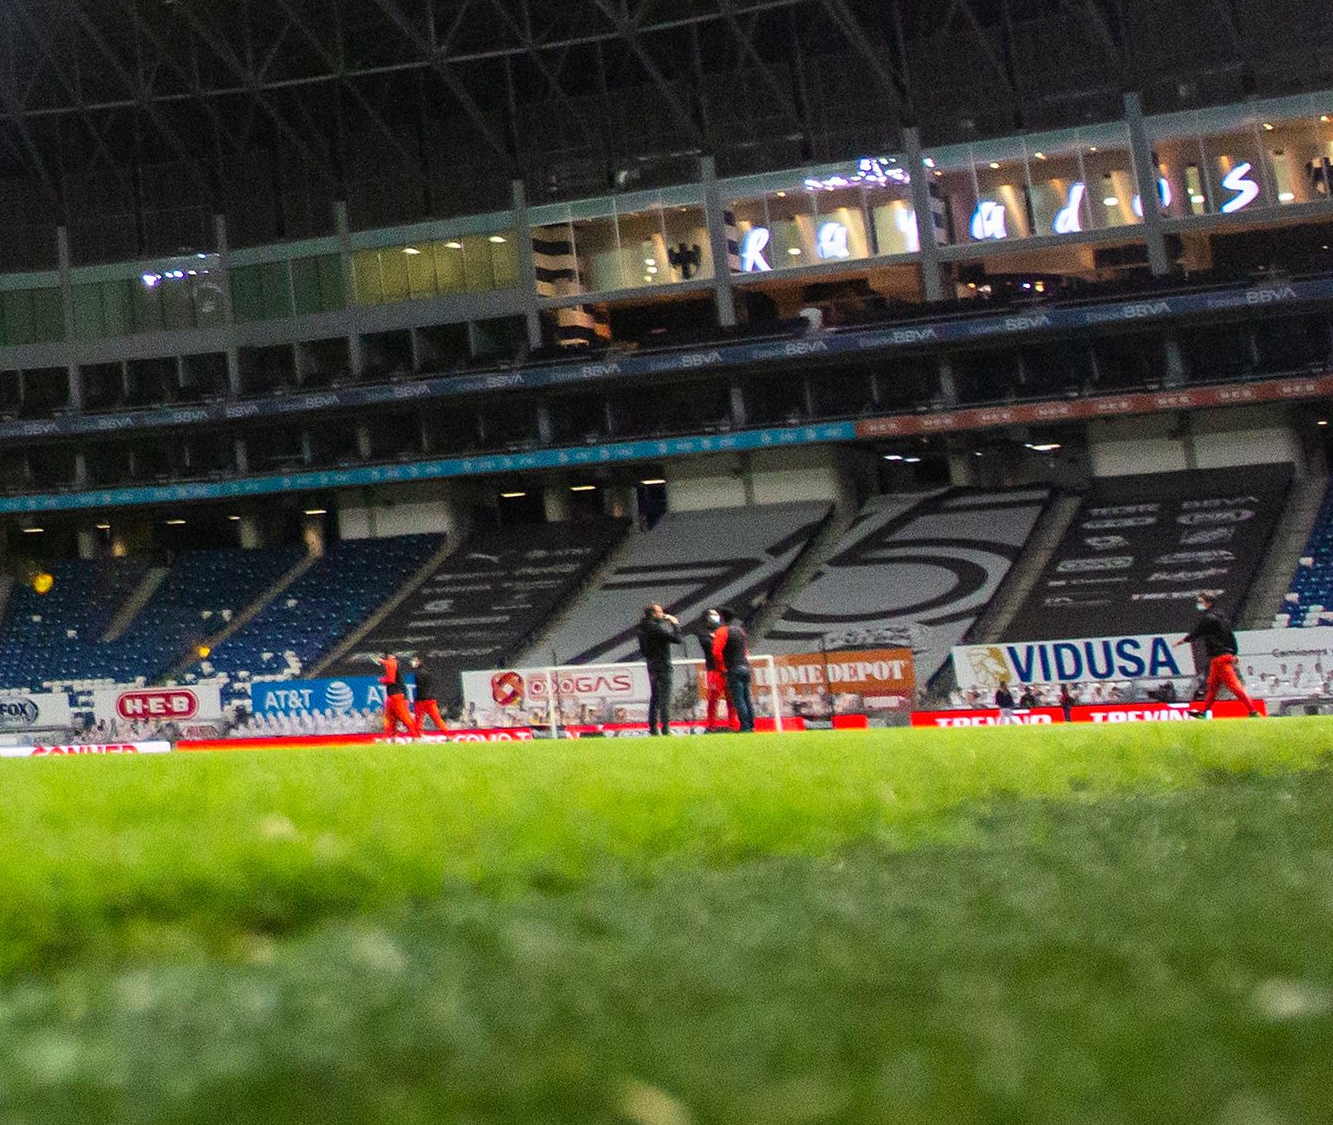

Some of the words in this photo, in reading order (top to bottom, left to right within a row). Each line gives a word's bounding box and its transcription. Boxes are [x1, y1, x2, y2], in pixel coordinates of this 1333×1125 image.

[1245, 287, 1296, 304] BBVA
[1123, 301, 1172, 318] BBVA
[786, 340, 828, 355] BBVA
[682, 352, 721, 367] BBVA
[1007, 637, 1181, 682] VIDUSA
[827, 660, 905, 682] DEPOT
[265, 689, 314, 710] AT&T
[367, 684, 416, 704] ATT
[0, 703, 29, 716] FOX
[125, 695, 190, 714] H-E-B
